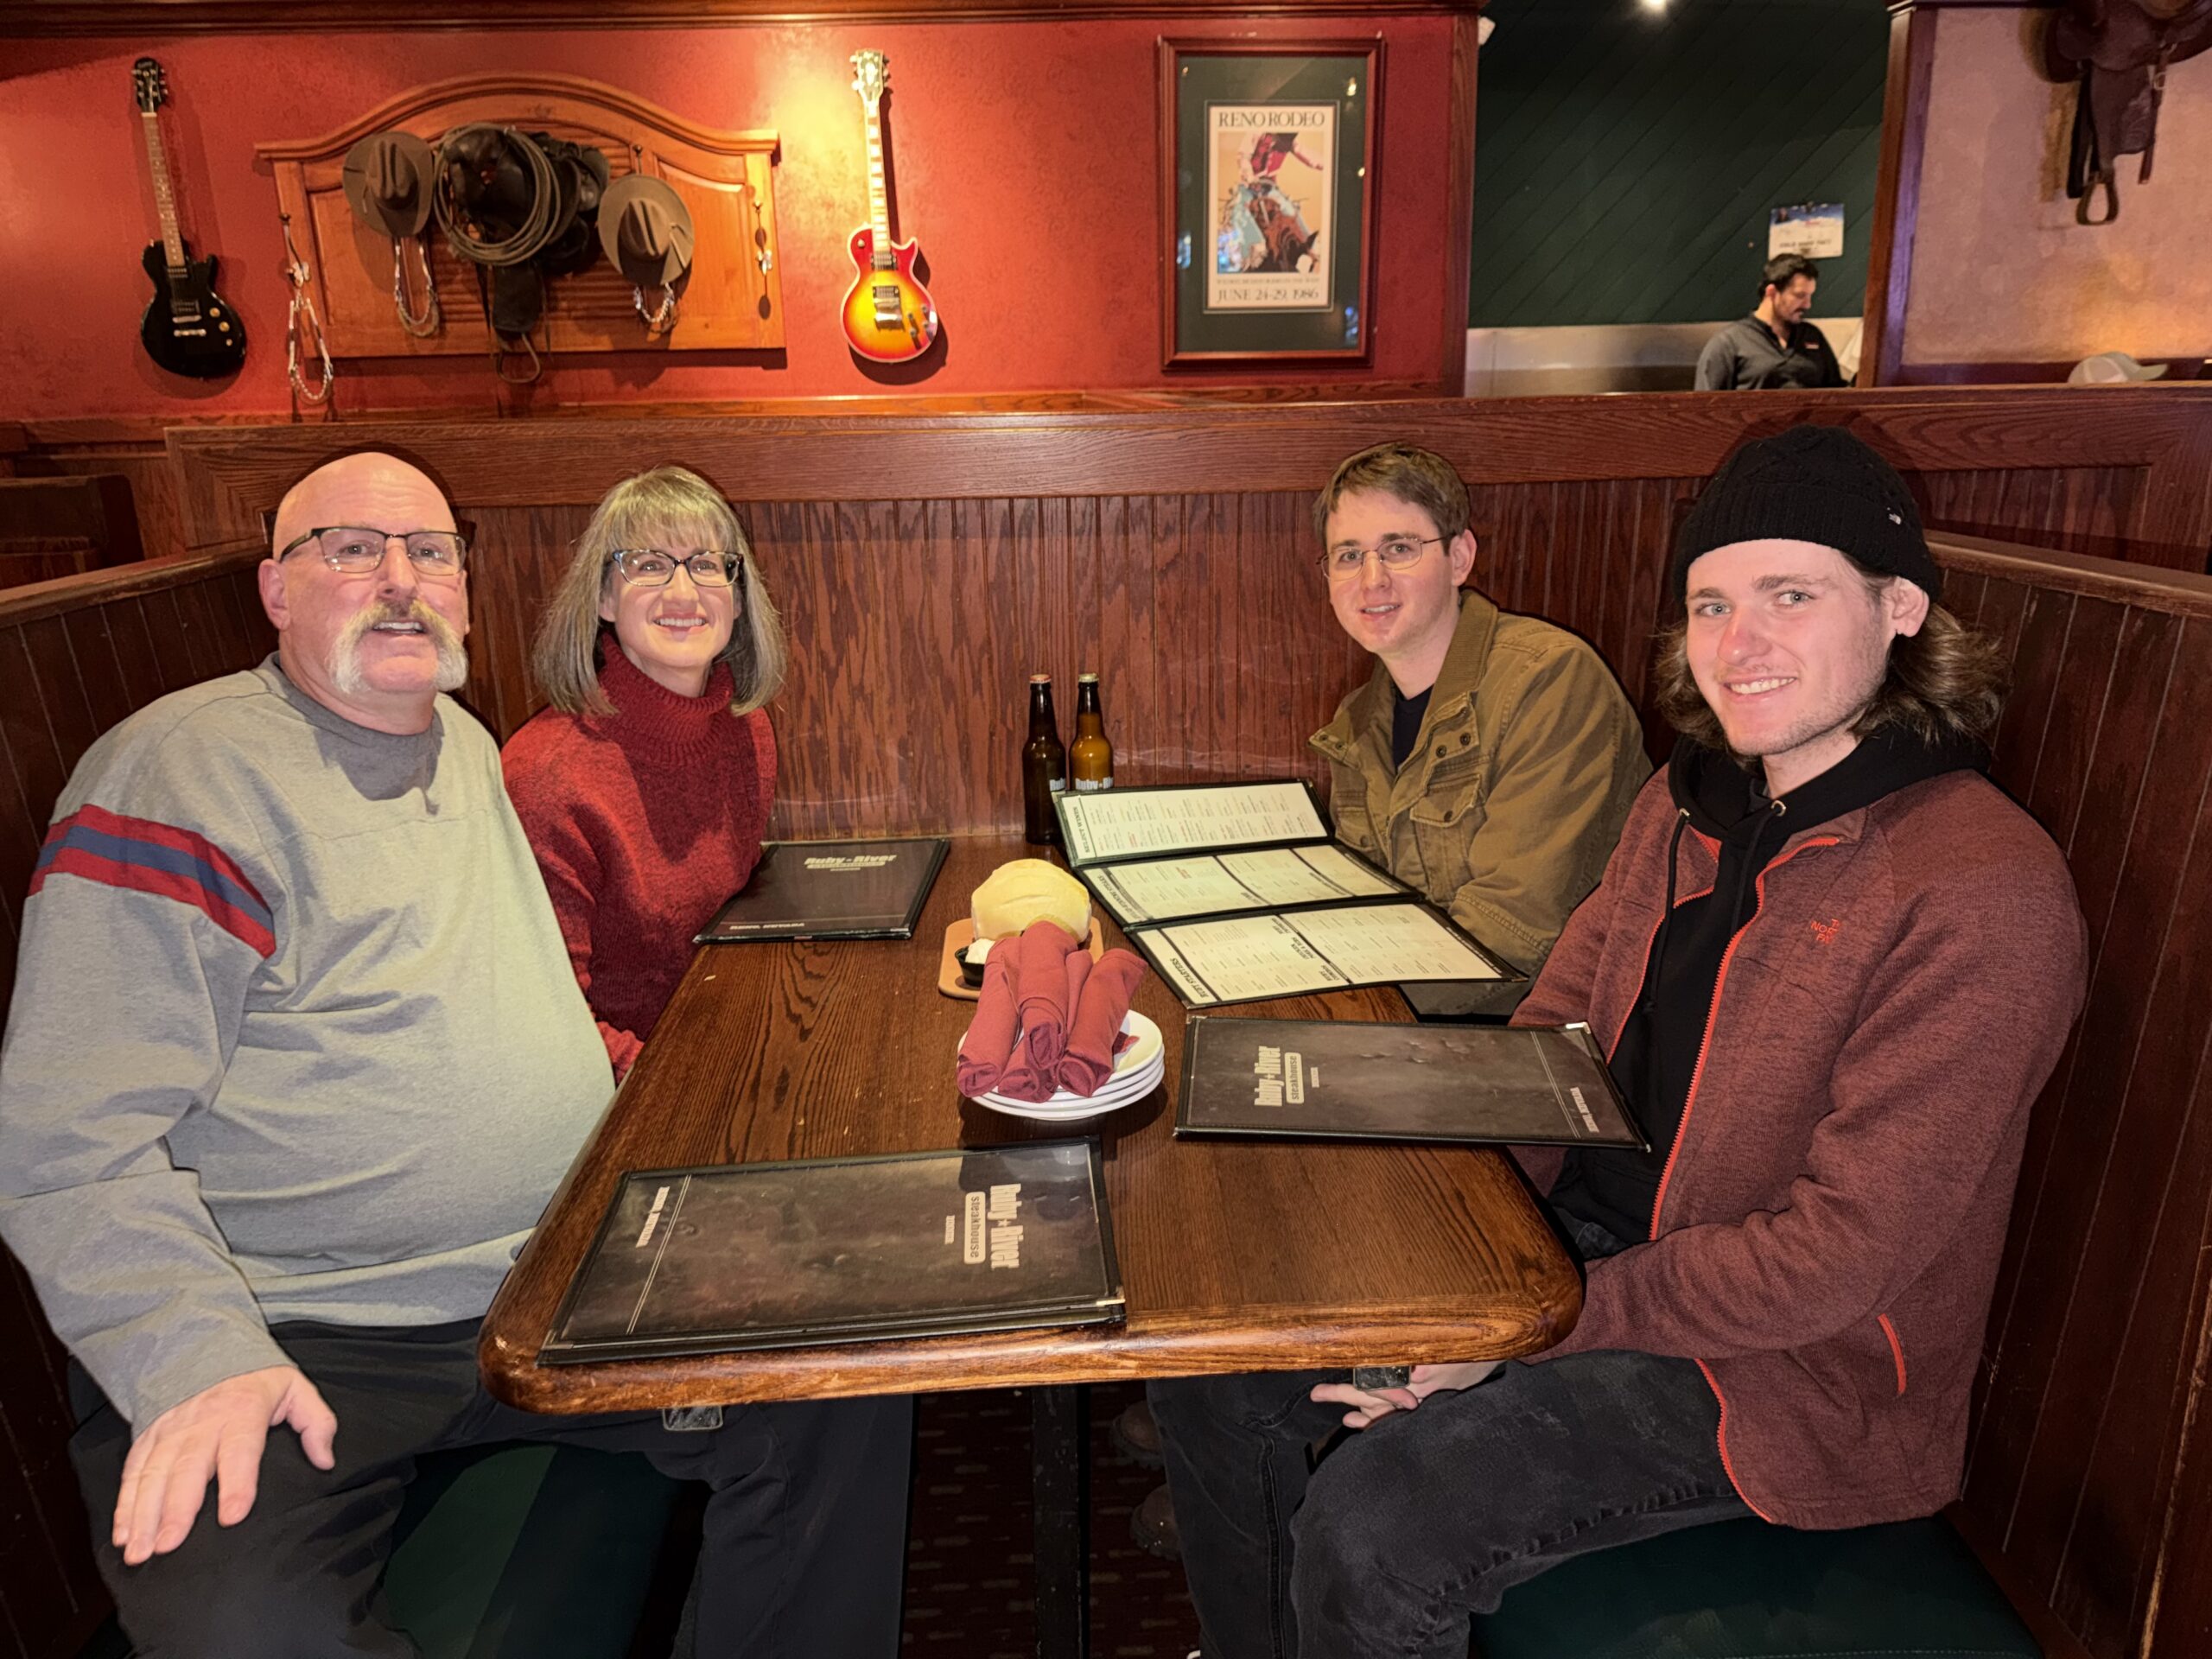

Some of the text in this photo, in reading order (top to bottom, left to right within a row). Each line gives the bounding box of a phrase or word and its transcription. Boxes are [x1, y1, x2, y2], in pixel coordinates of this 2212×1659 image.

[1218, 111, 1325, 127] RENO RODEO
[1217, 289, 1250, 303] JUNE
[1293, 288, 1319, 300] 1986
[804, 856, 846, 866] Ruby
[853, 855, 897, 863] River
[1254, 1046, 1285, 1107] Ruby River
[1288, 1055, 1300, 1100] steakhouse
[969, 1196, 981, 1258] steakhouse
[987, 1183, 1024, 1269] Ruby River
